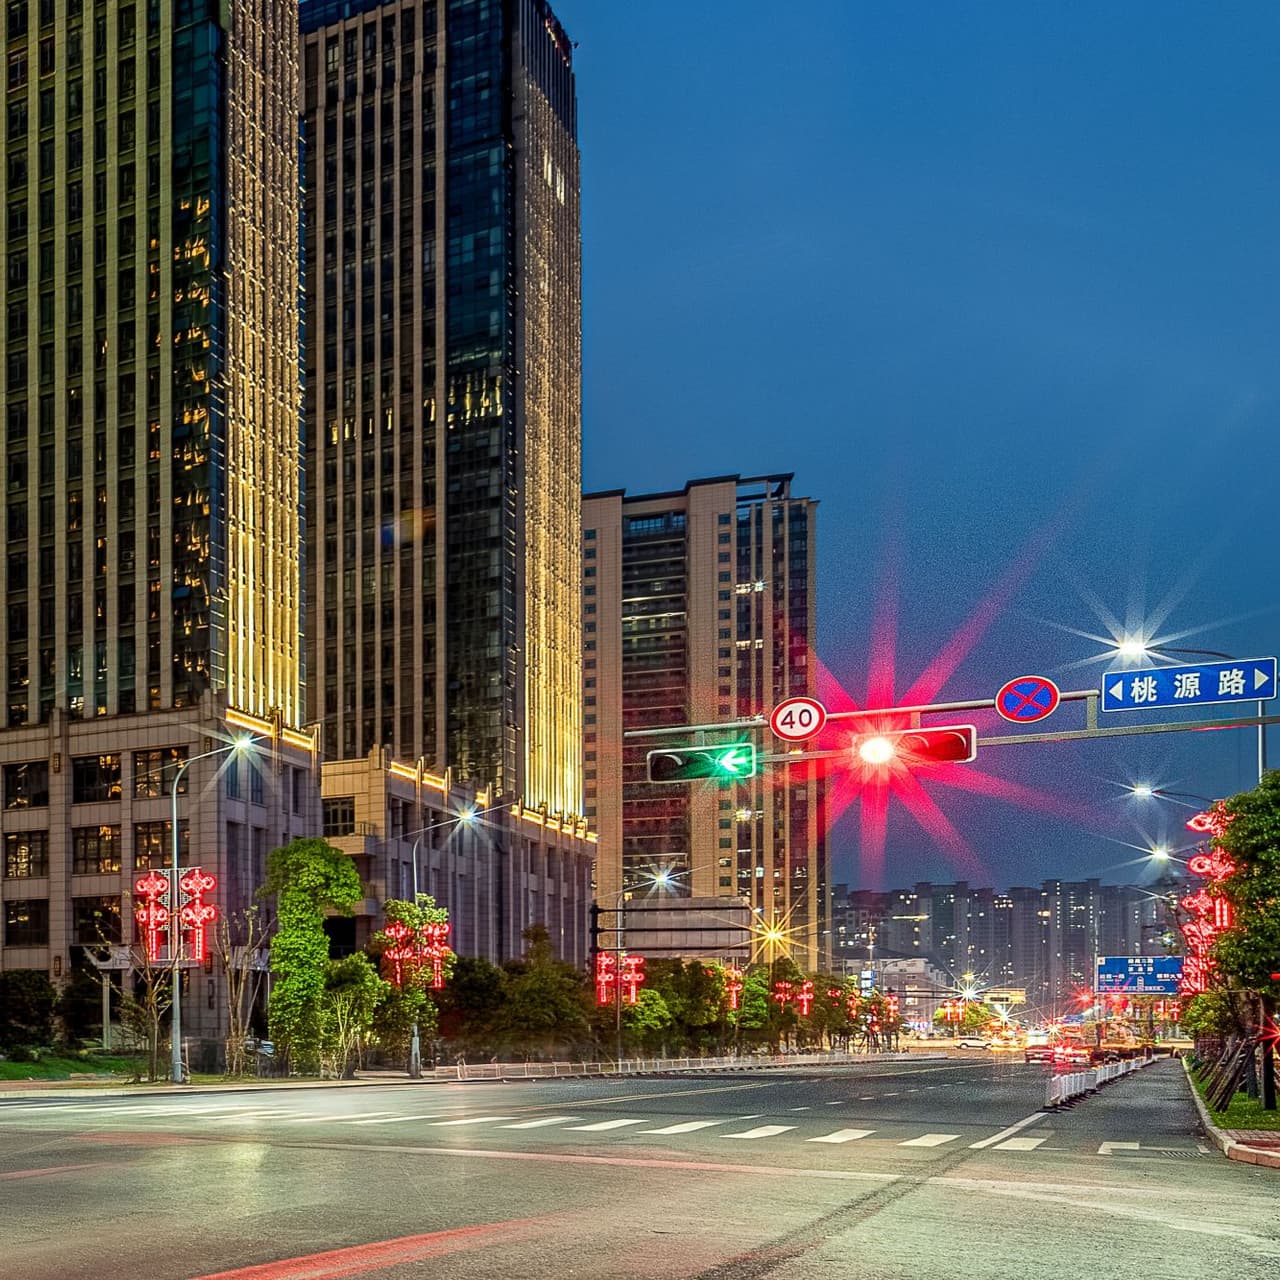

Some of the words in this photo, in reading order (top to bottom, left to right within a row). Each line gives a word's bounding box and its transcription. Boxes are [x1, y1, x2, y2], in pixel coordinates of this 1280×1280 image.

[1131, 668, 1246, 704] 桃源路
[780, 708, 813, 729] 40
